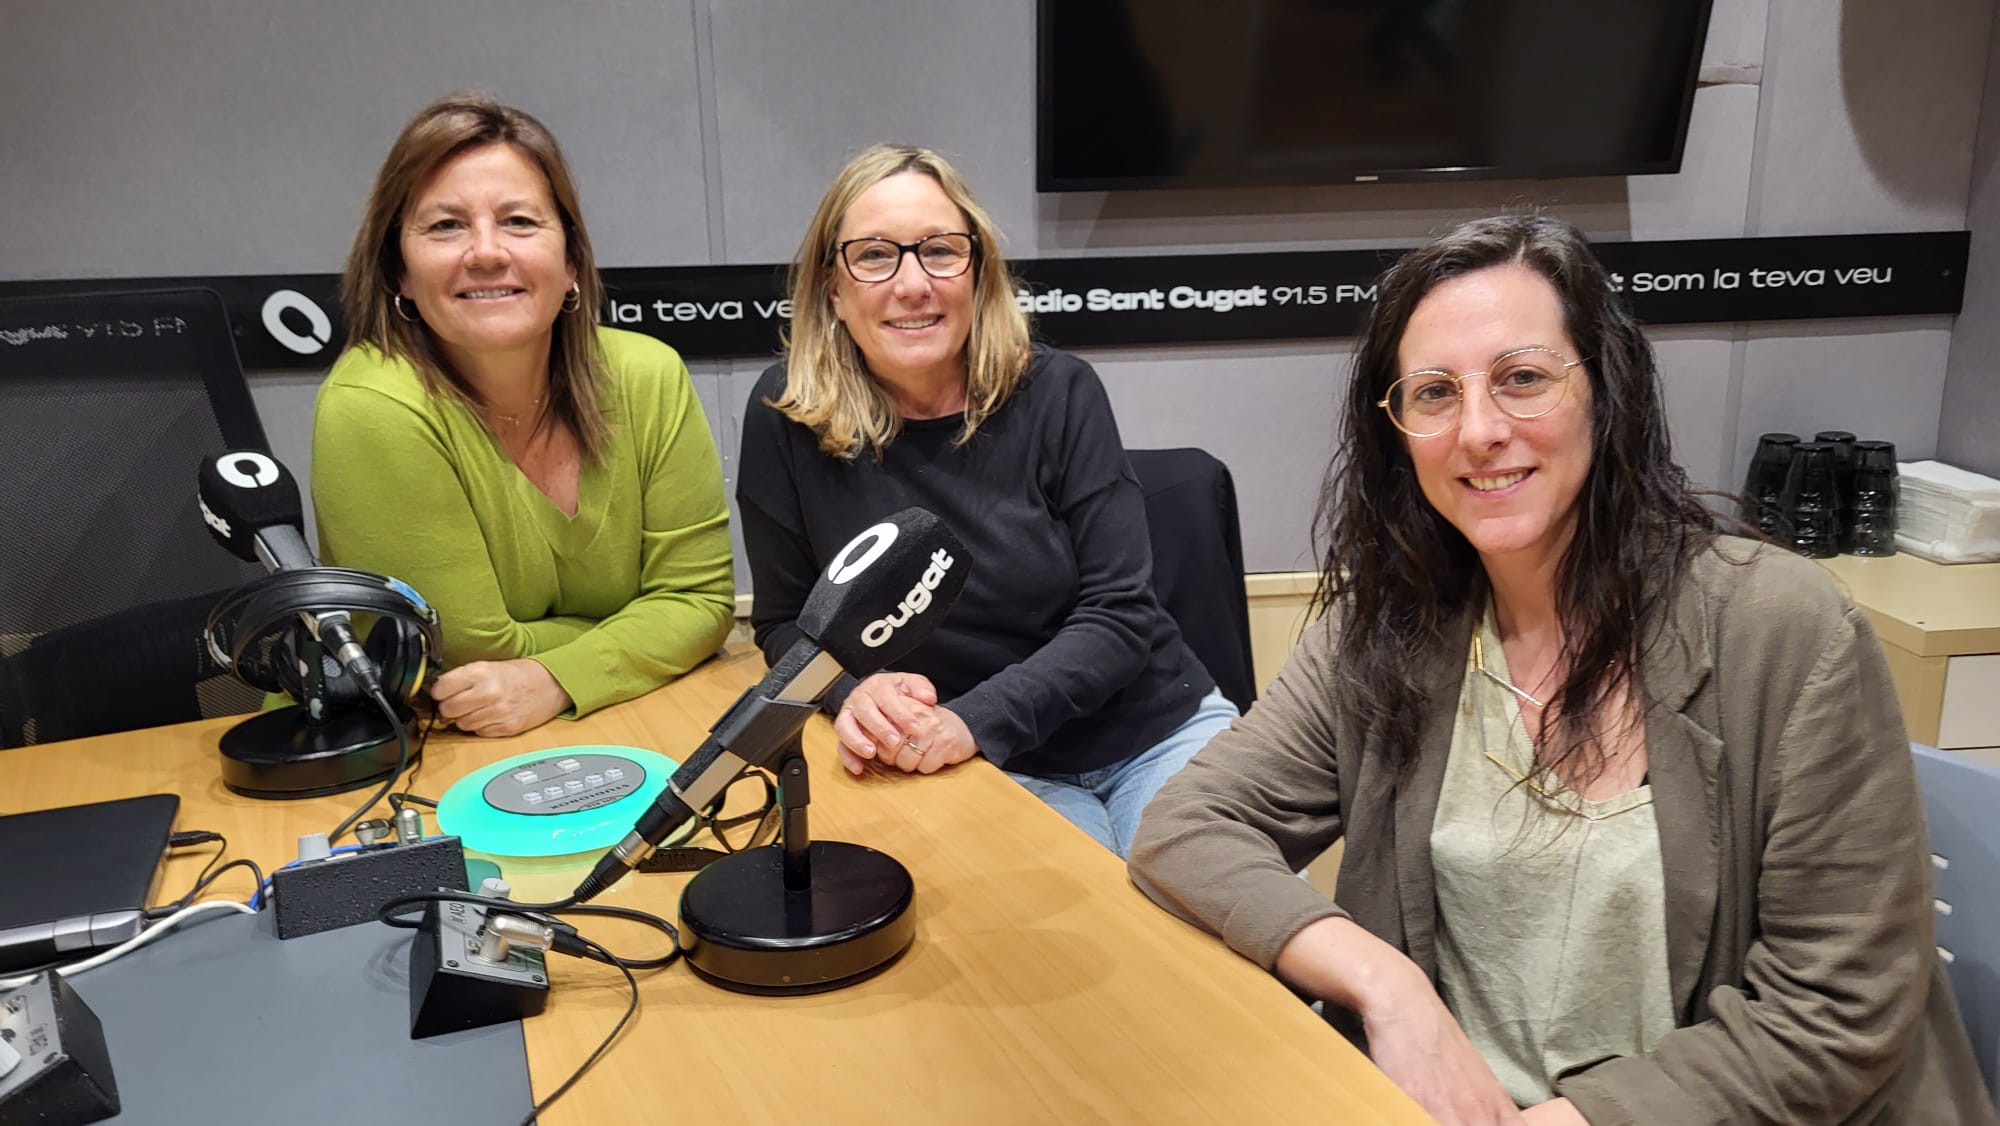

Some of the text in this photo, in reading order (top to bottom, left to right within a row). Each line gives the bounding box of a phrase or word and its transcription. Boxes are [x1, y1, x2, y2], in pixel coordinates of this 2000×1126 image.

[1631, 271, 1704, 293] Som
[1712, 268, 1740, 290] la
[1749, 267, 1825, 288] teva
[1833, 265, 1892, 285] veu
[610, 299, 643, 323] la
[652, 299, 744, 323] teva
[752, 299, 796, 319] ve
[1014, 284, 1378, 313] àdio Sant Cugat 91.5 FM
[860, 548, 955, 648] Cugat
